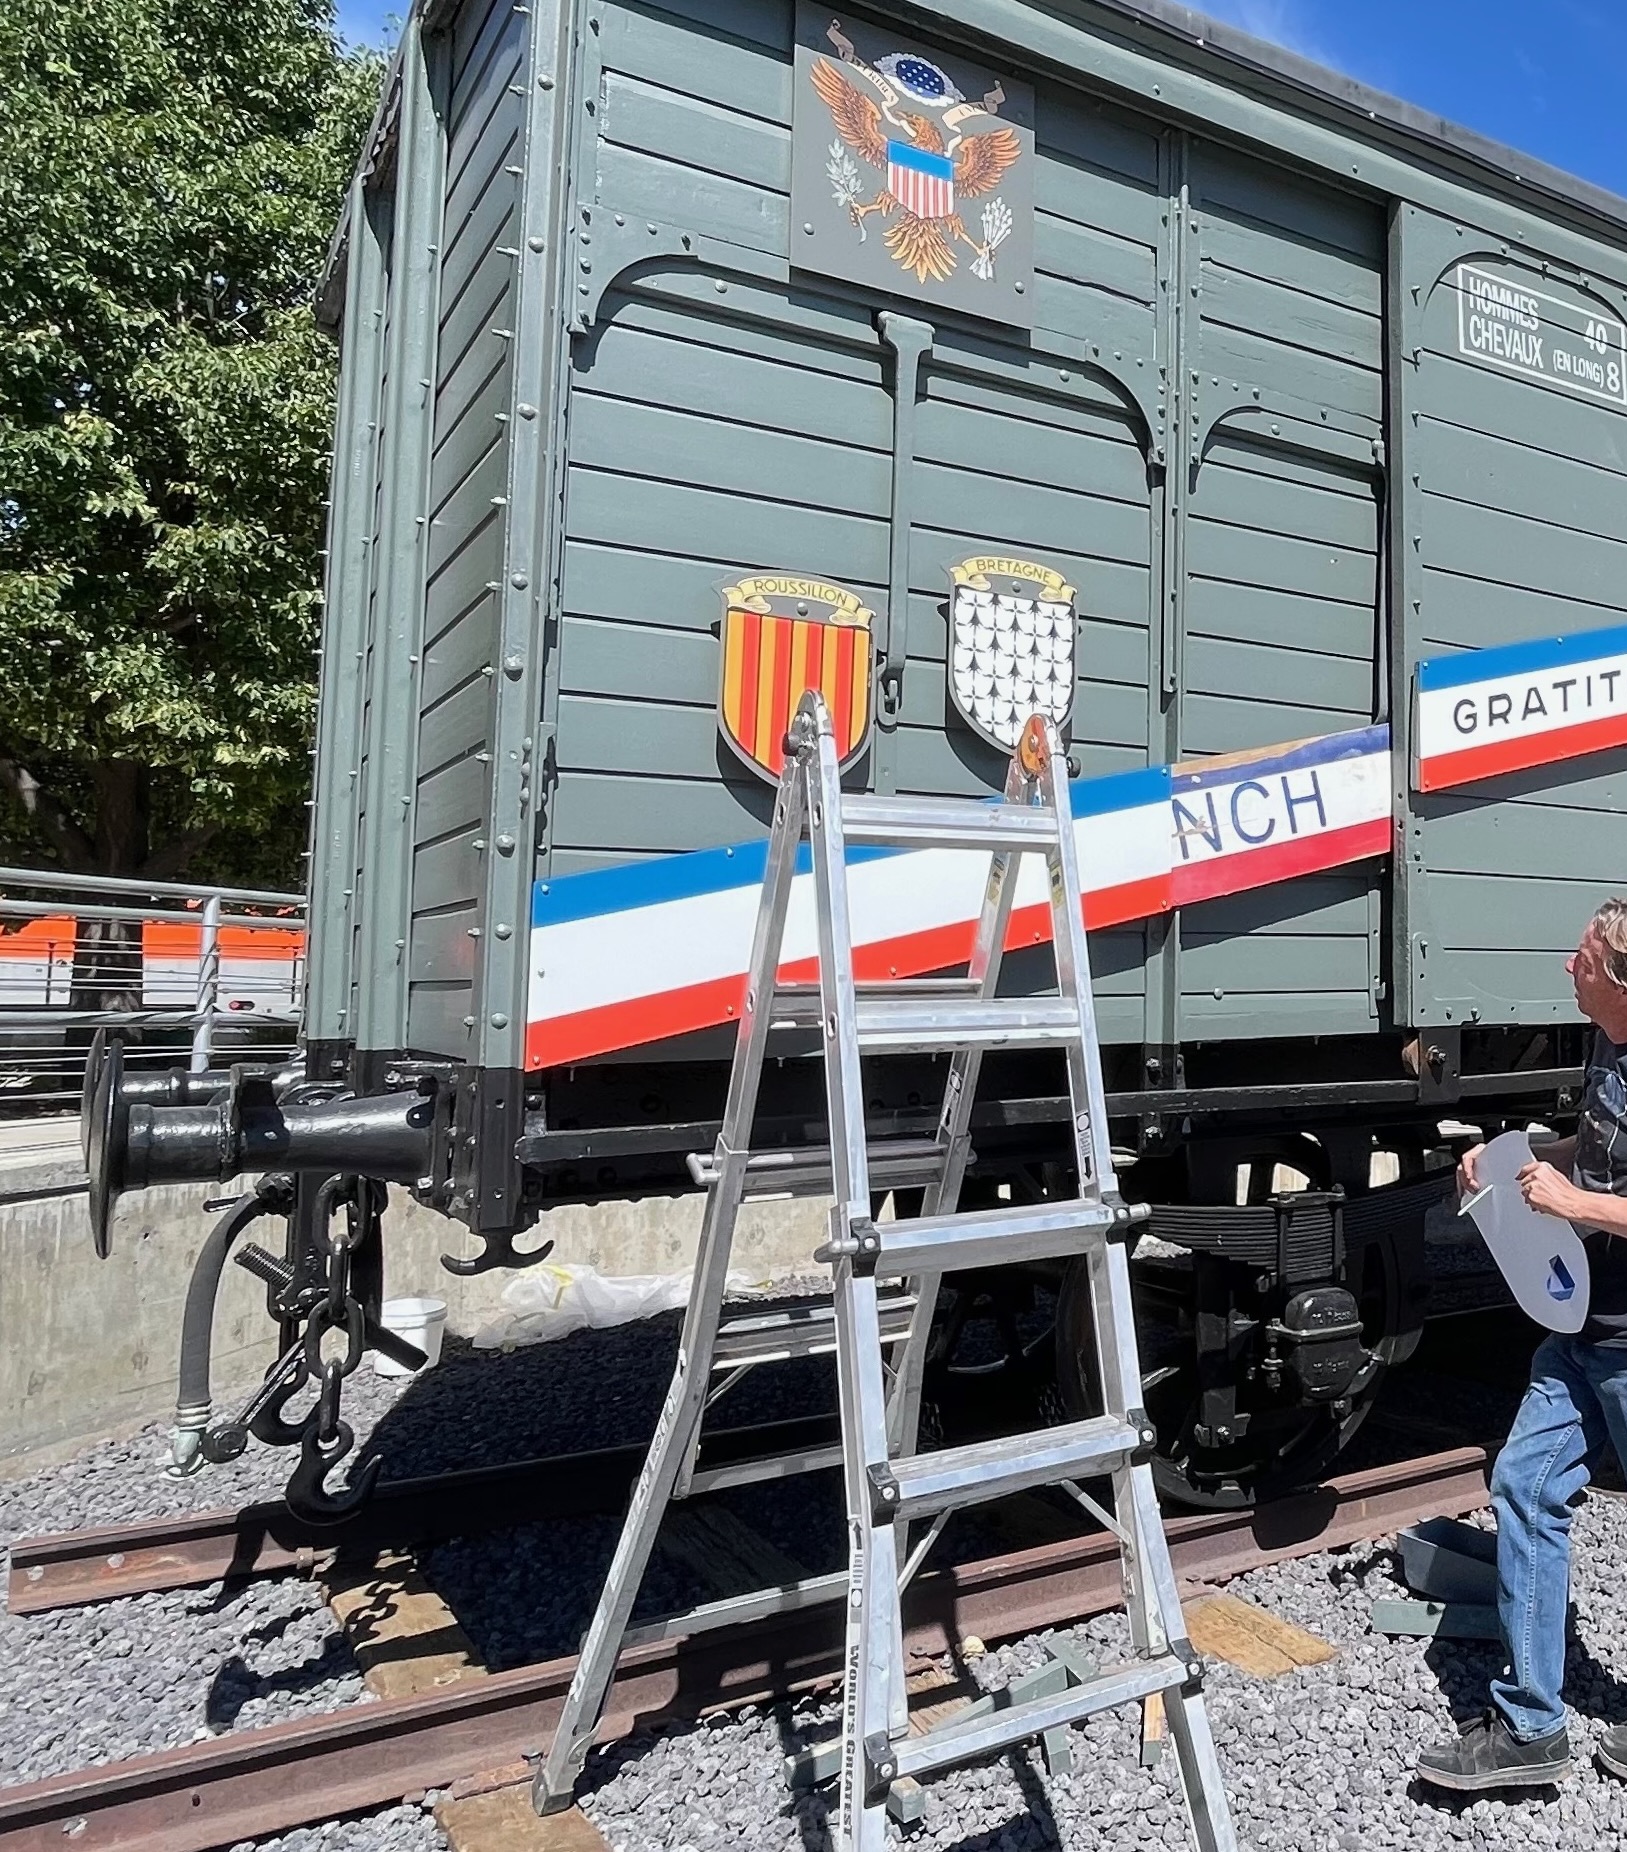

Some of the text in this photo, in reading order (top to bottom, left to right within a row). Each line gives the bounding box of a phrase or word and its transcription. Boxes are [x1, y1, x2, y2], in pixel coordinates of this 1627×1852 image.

[1469, 276, 1608, 355] HOMMES 40
[1469, 315, 1621, 393] CHEVAUX (EN LONG) 8
[753, 579, 850, 606] ROUSSILLON
[976, 559, 1051, 583] BRETAGNE
[1171, 770, 1327, 860] NCH
